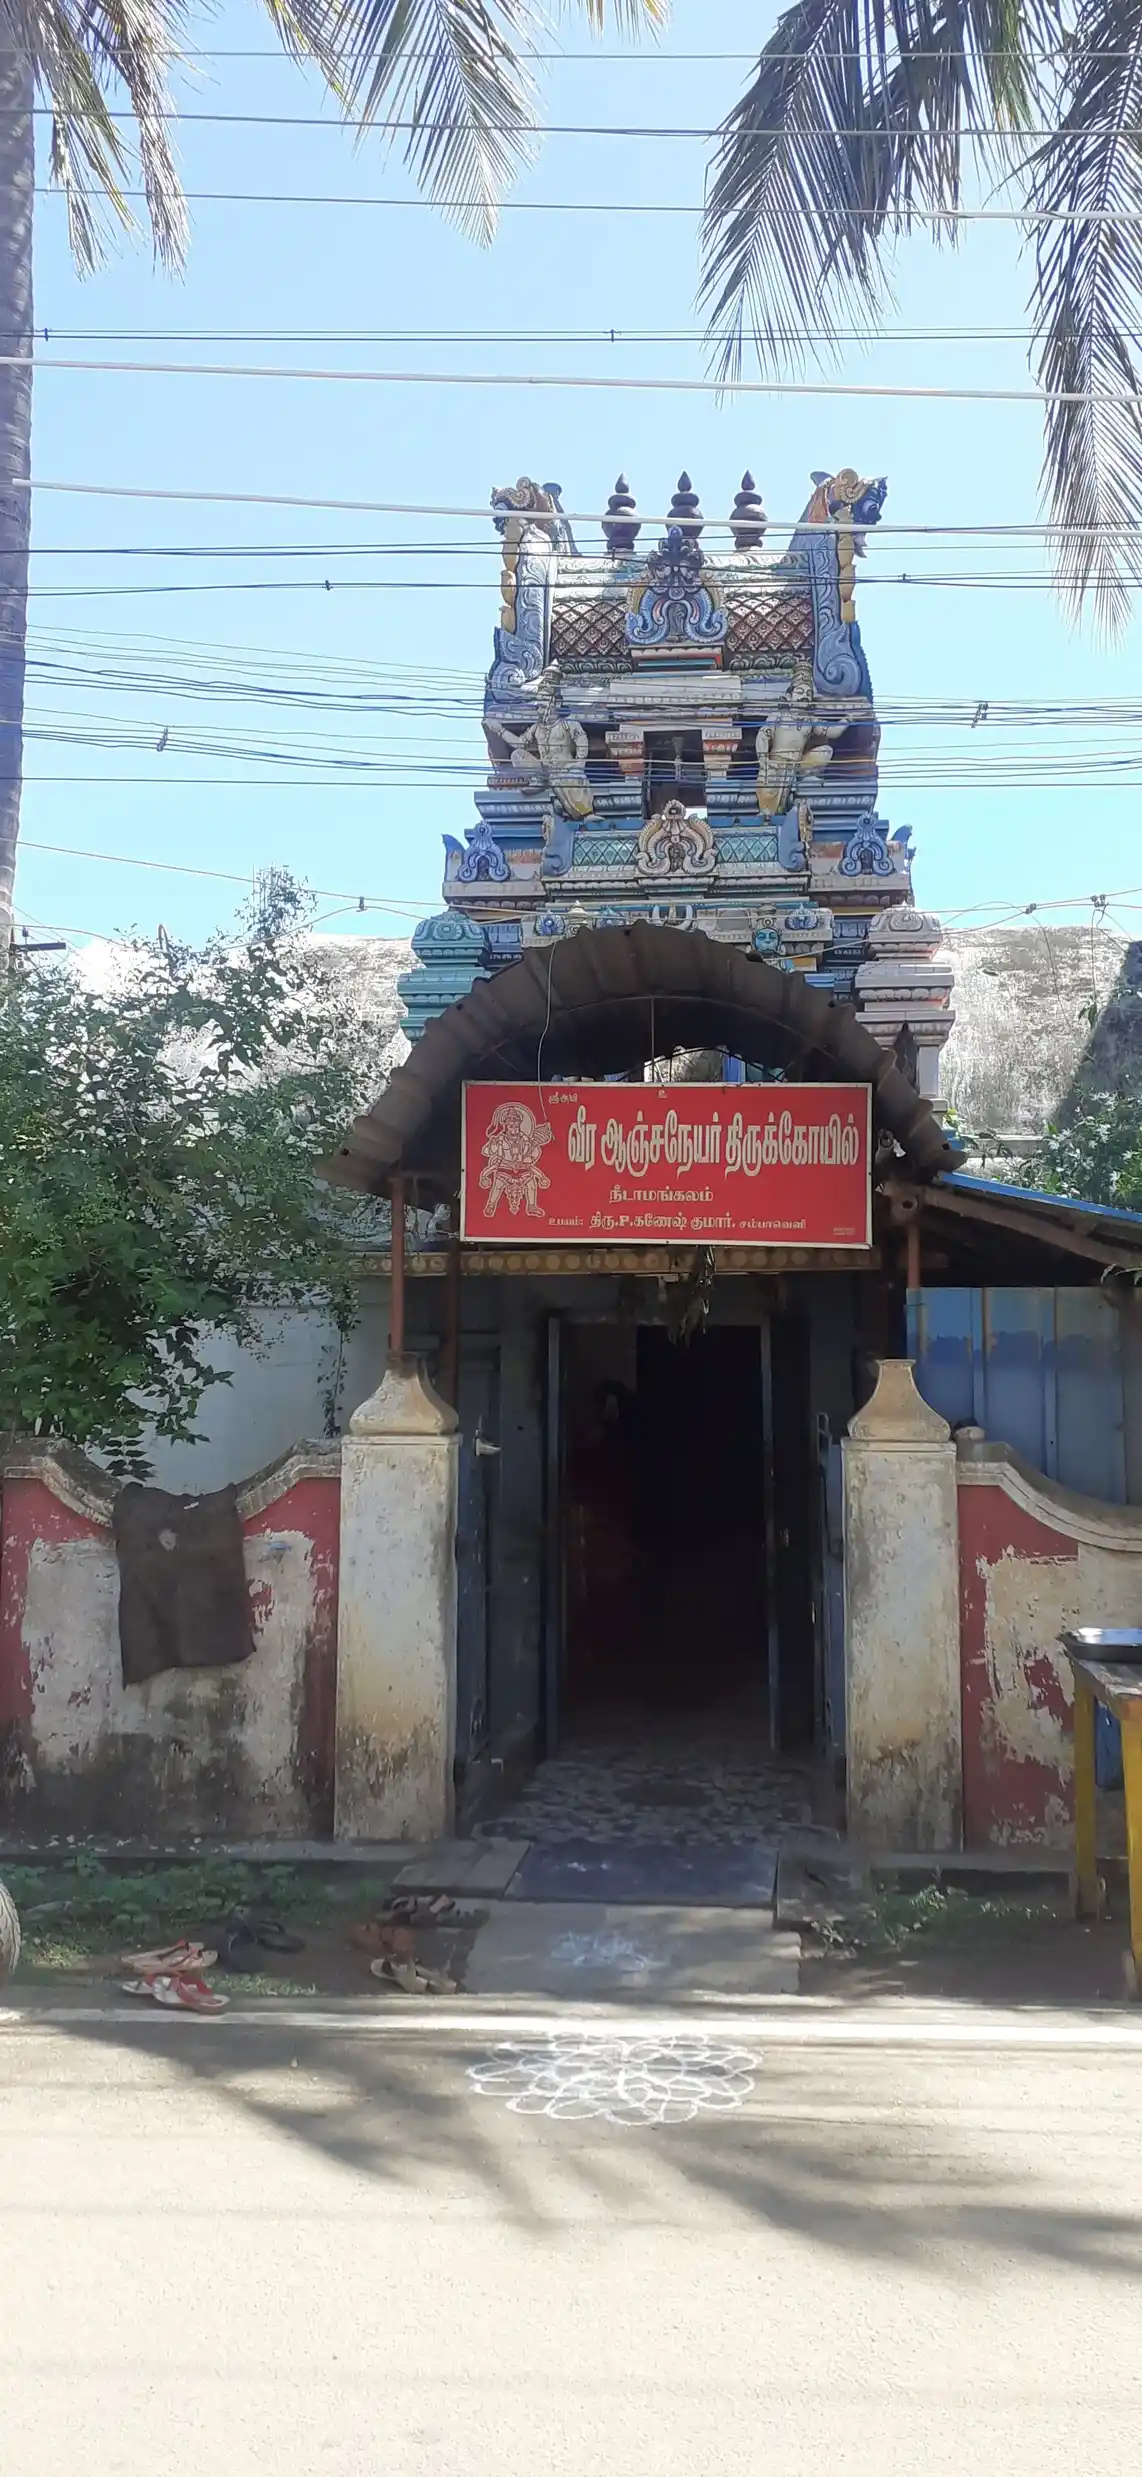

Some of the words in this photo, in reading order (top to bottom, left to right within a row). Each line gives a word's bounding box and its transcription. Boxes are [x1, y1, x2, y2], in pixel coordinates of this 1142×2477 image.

[568, 1105, 597, 1171] வீர
[601, 1109, 721, 1180] ஆஞ்சநேயர்
[725, 1110, 859, 1180] திருக்கோயில்
[609, 1184, 714, 1204] நீடாமங்கலம்
